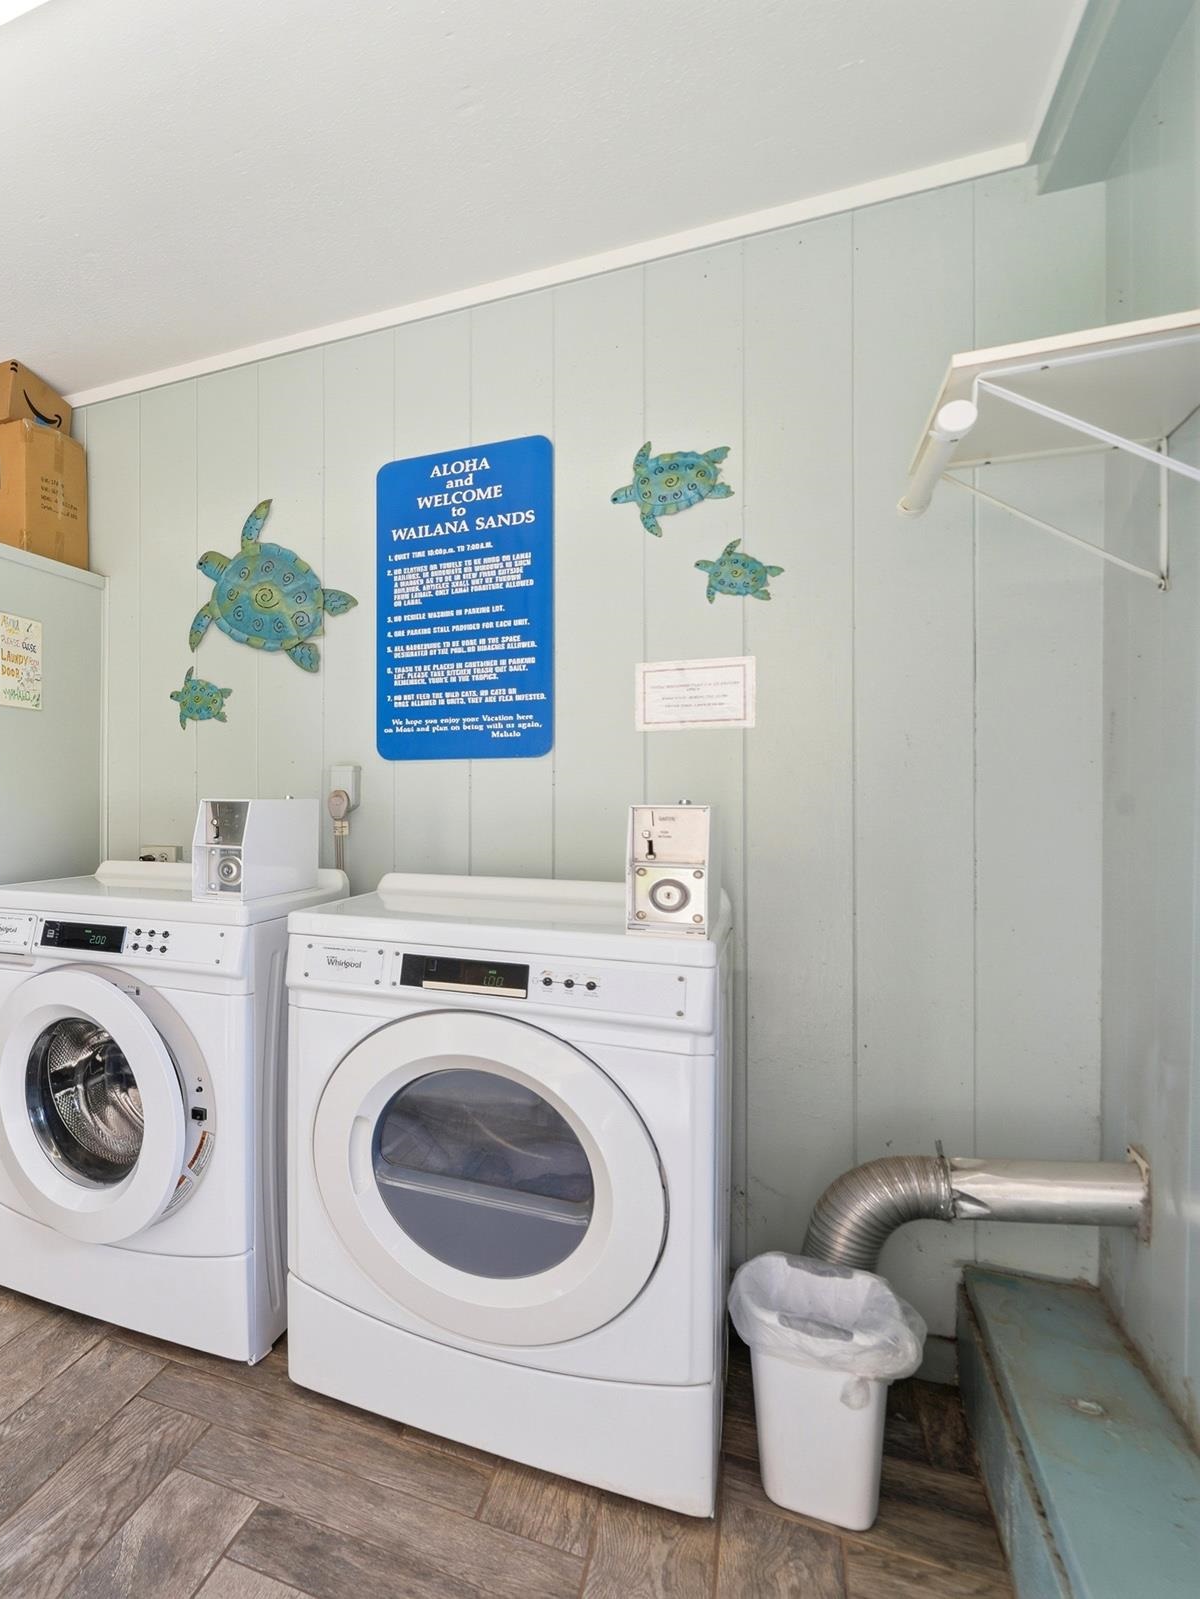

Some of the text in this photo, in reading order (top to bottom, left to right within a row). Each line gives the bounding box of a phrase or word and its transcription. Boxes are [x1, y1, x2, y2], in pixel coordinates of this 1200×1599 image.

[430, 457, 490, 478] ALOHA
[445, 473, 474, 489] and
[417, 484, 503, 510] WELCOME
[451, 507, 467, 517] to
[392, 510, 536, 542] WAILANA SANDS
[411, 551, 425, 559] TIME
[464, 606, 490, 615] PARKING
[407, 628, 431, 636] PARKING
[452, 623, 480, 632] PROVIDED
[405, 718, 423, 726] hope
[432, 724, 448, 733] plan
[491, 730, 521, 738] Mahalo
[327, 958, 362, 968] Whirlpool
